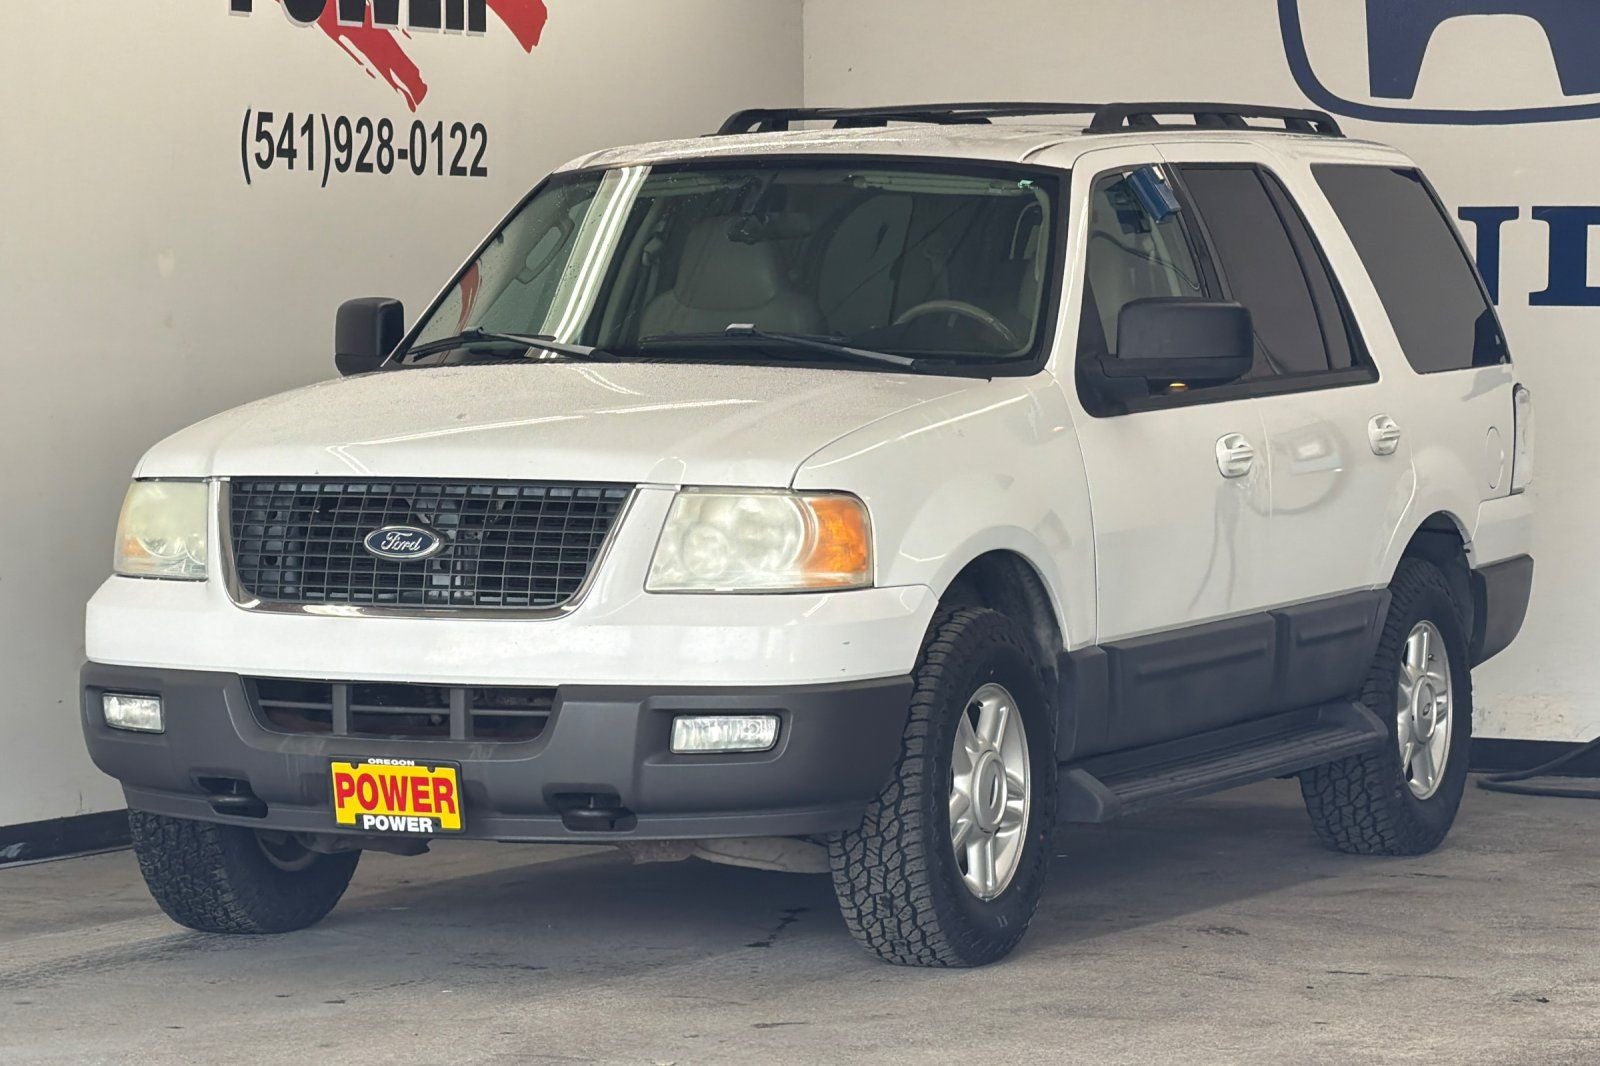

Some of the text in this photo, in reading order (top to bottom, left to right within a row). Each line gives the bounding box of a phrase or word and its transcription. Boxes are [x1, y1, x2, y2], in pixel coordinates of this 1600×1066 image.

[241, 107, 488, 188] (541)928-0122
[380, 531, 422, 551] Ford
[367, 757, 415, 766] OREGON
[335, 772, 456, 814] POWER
[362, 814, 434, 833] POWER
